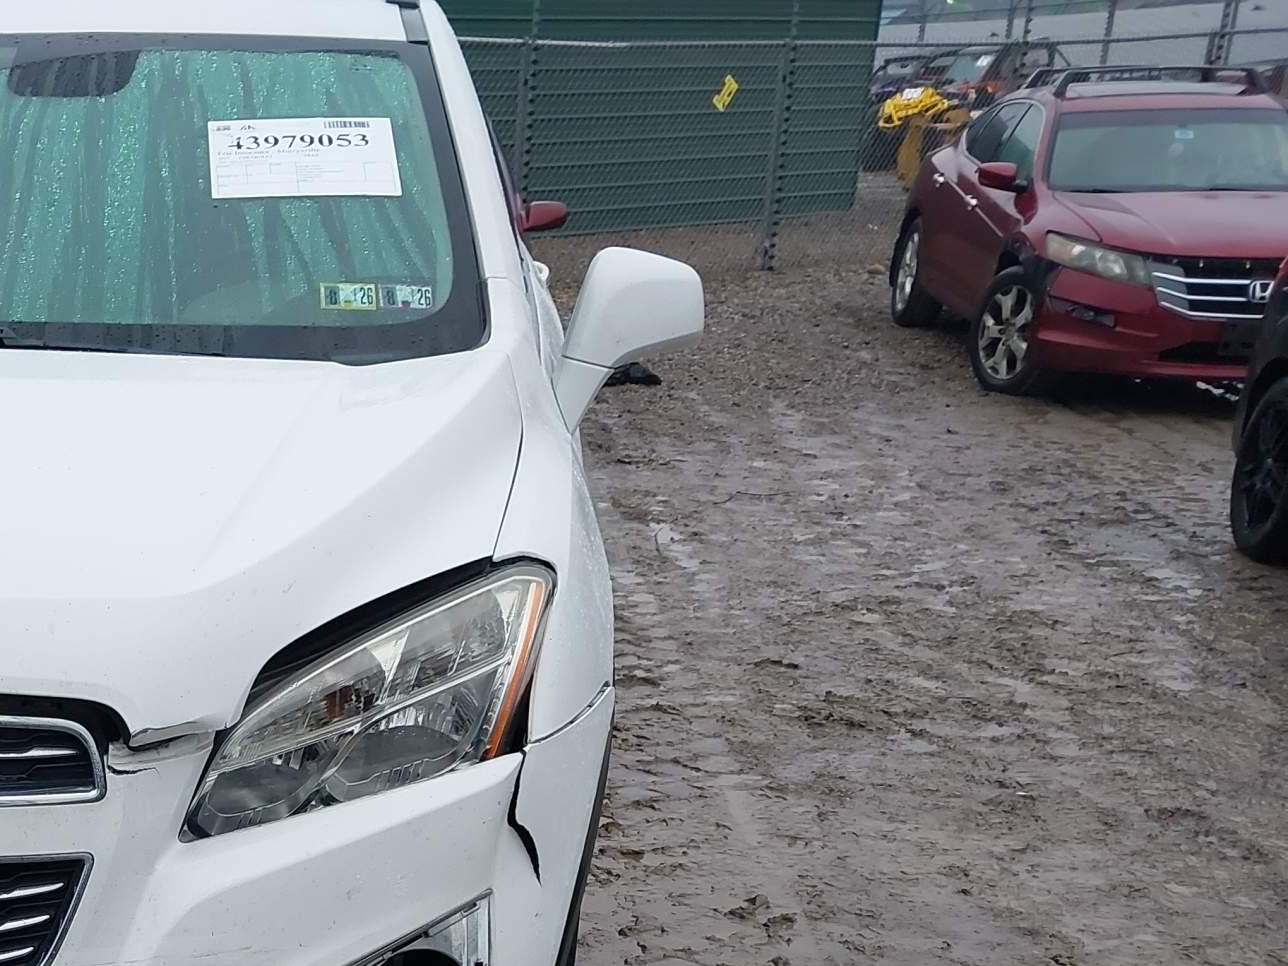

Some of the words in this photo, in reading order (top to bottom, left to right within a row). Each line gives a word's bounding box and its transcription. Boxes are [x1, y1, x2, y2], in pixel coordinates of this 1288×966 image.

[228, 133, 370, 151] 43979053
[359, 286, 374, 305] 26
[417, 288, 431, 306] 26
